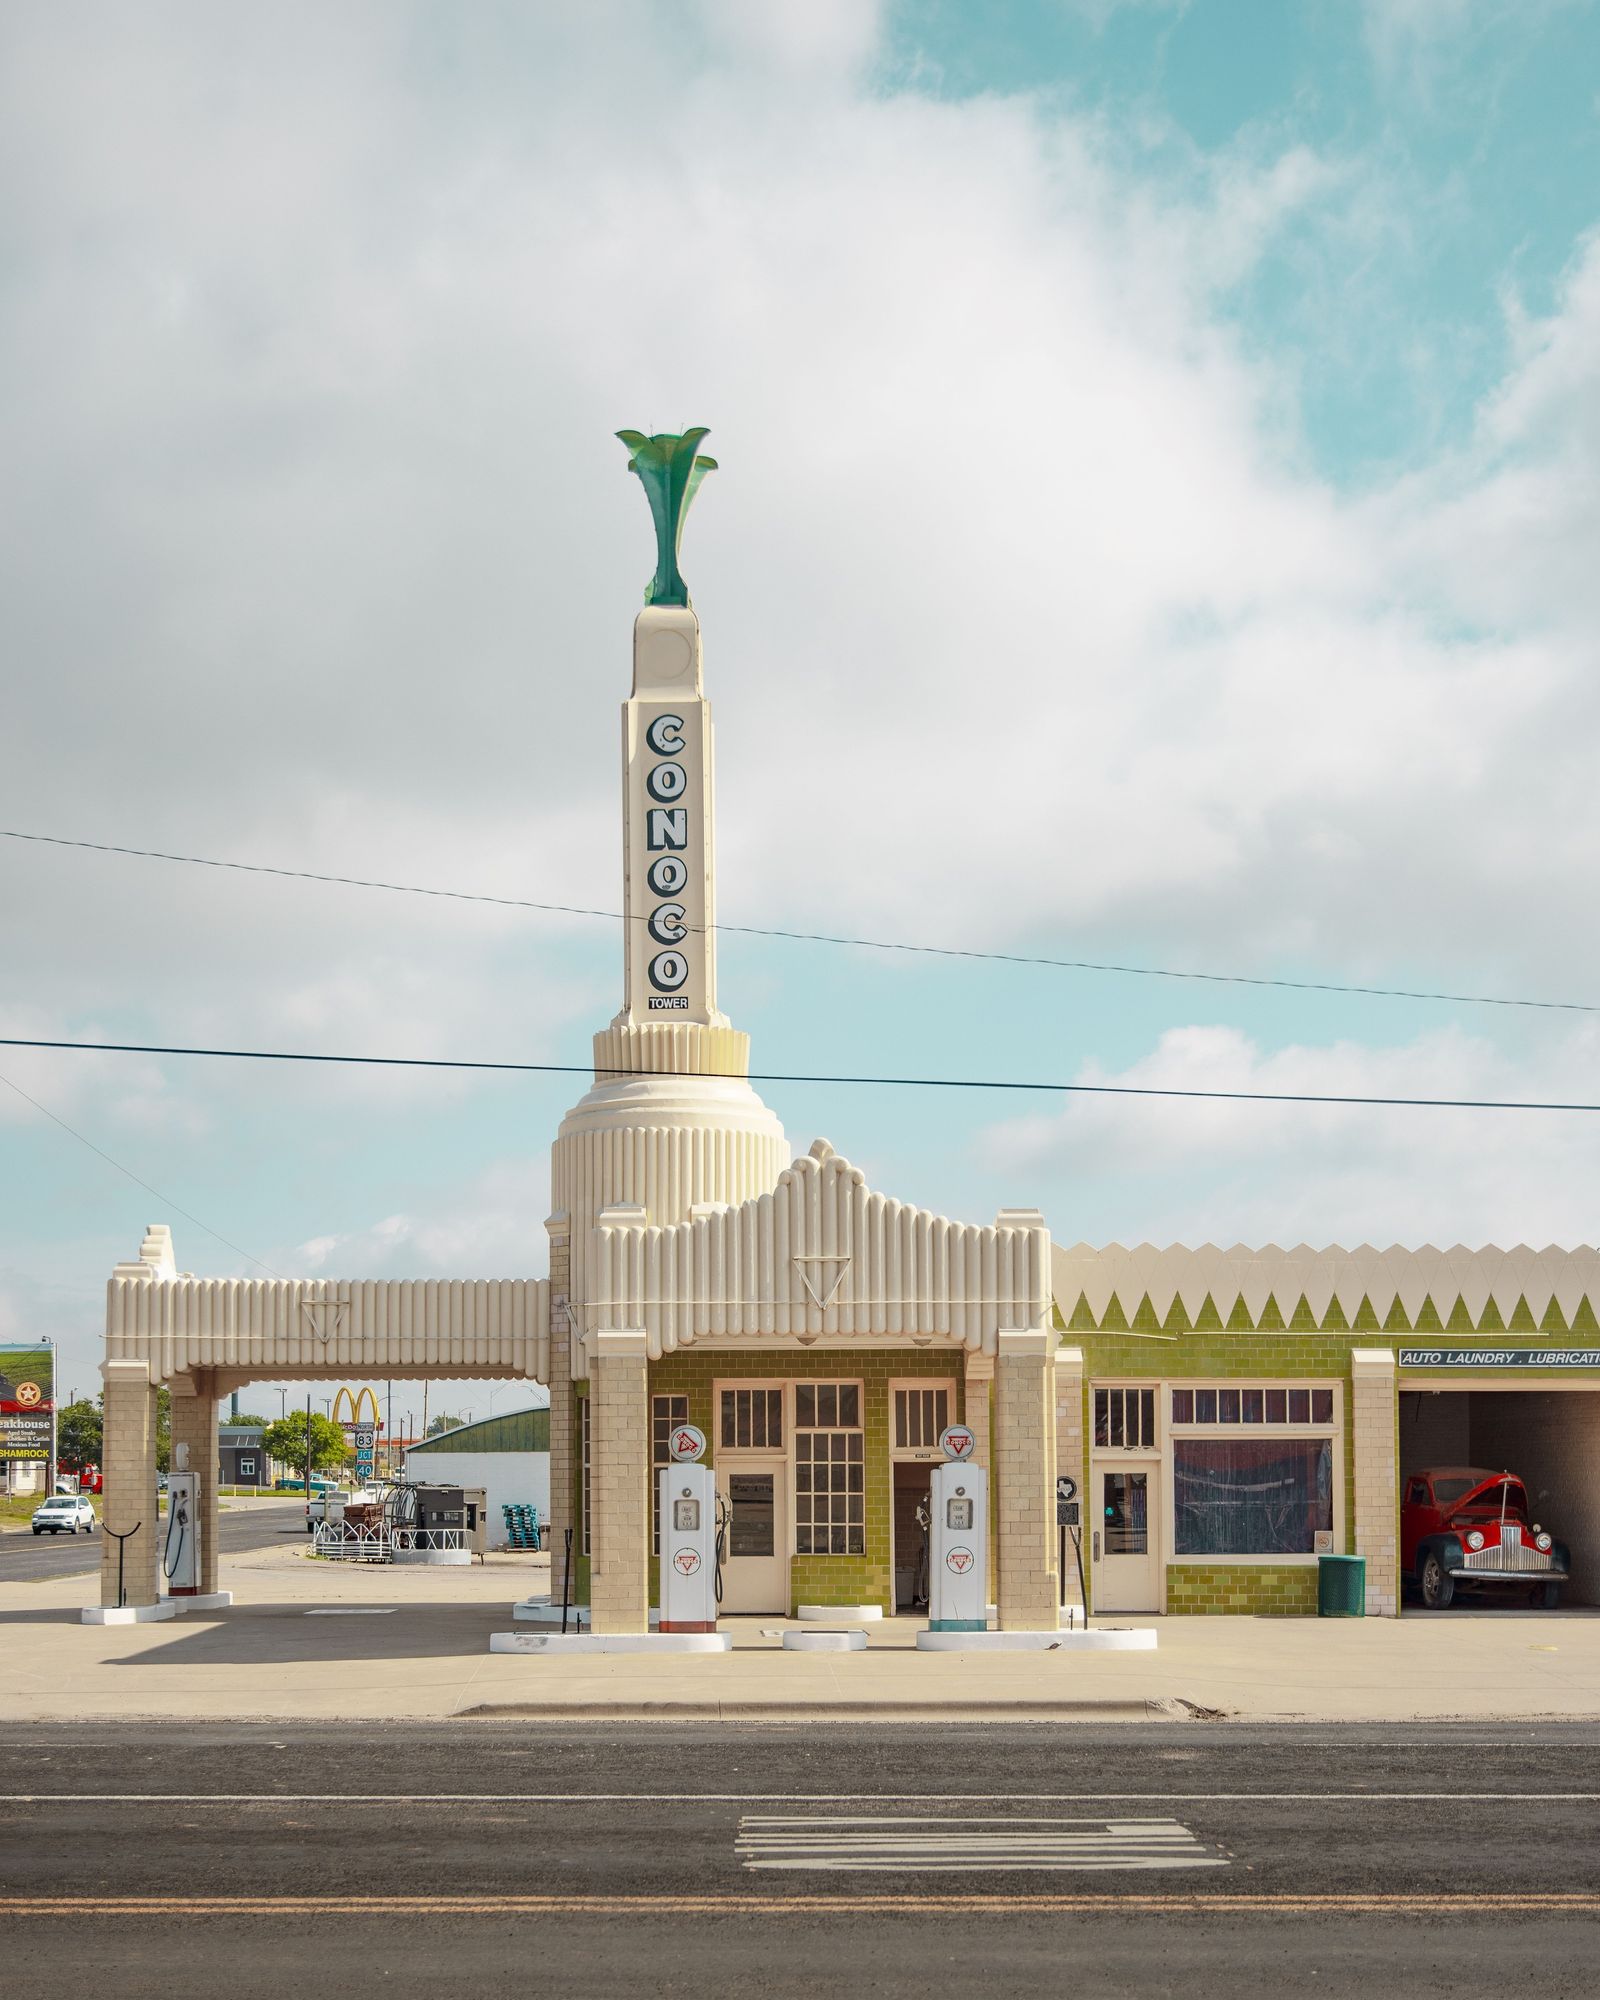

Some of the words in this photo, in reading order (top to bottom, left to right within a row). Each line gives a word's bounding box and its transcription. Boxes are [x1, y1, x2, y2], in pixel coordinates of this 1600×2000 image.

[646, 714, 688, 993] CONOCO
[649, 997, 688, 1009] TOWER
[1402, 1352, 1441, 1364] AUTO
[1446, 1352, 1515, 1364] LAUNDRY
[1528, 1352, 1600, 1364] LUBRICATI
[358, 1436, 372, 1446] 83
[0, 1450, 49, 1458] SHAMROCK
[358, 1451, 371, 1459] JCT
[358, 1466, 372, 1475] 40
[734, 1815, 1231, 1871] ONLY
